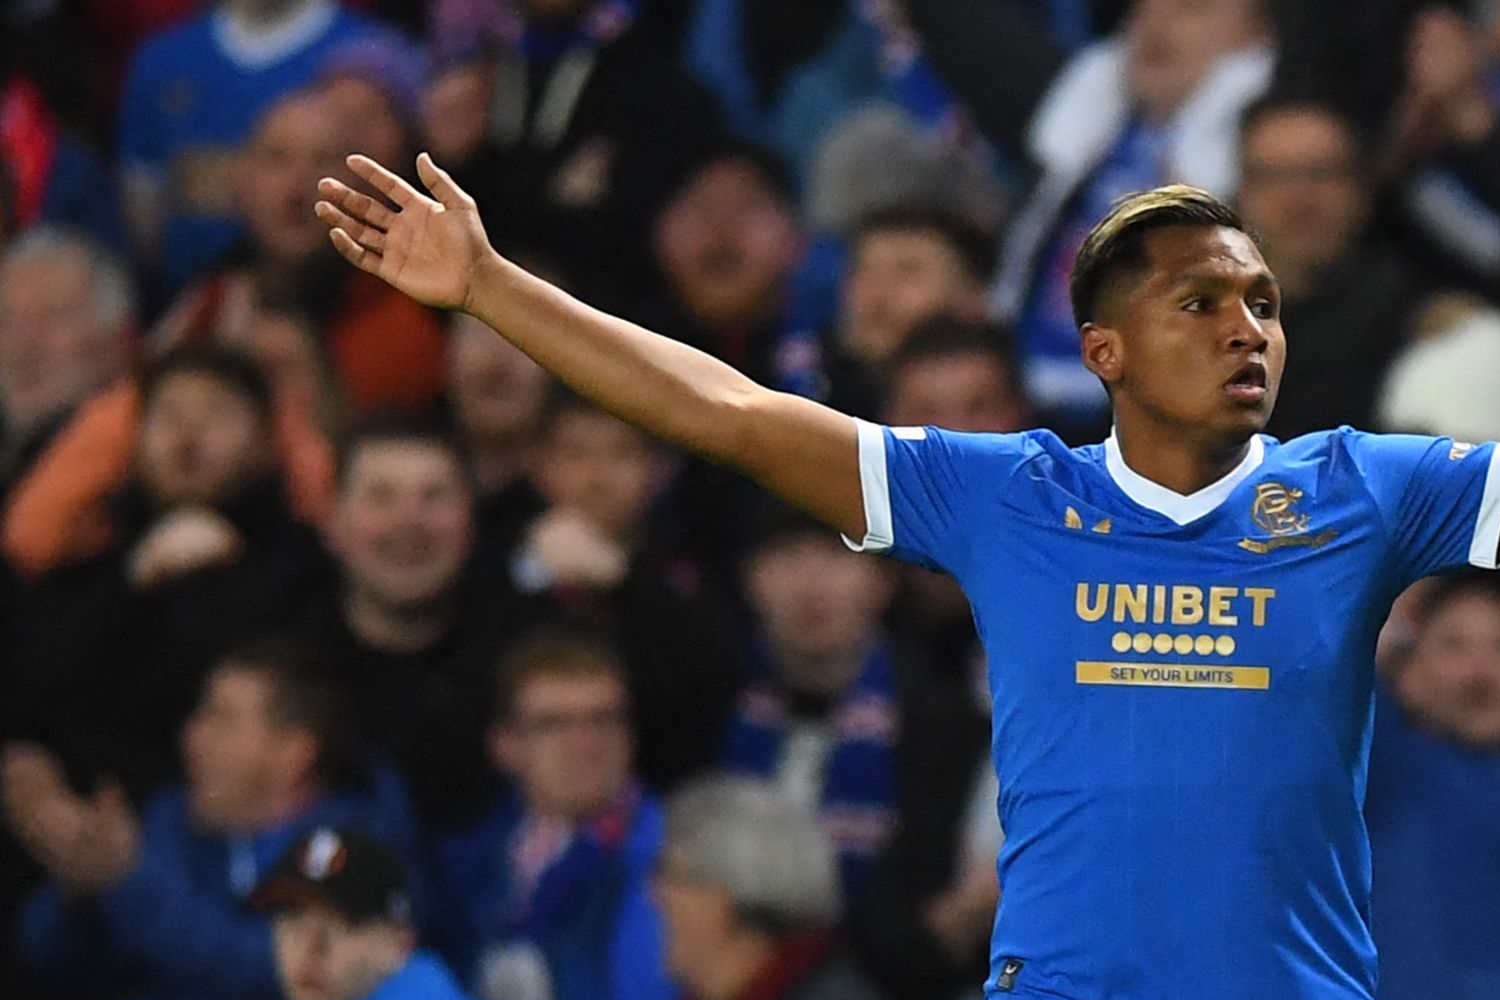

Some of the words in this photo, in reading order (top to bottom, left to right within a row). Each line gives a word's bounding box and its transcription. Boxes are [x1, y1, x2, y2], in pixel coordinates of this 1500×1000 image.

[1075, 582, 1276, 627] UNIBET
[1110, 666, 1137, 681] SET
[1141, 668, 1181, 682] YOUR
[1185, 670, 1234, 684] LIMITS
